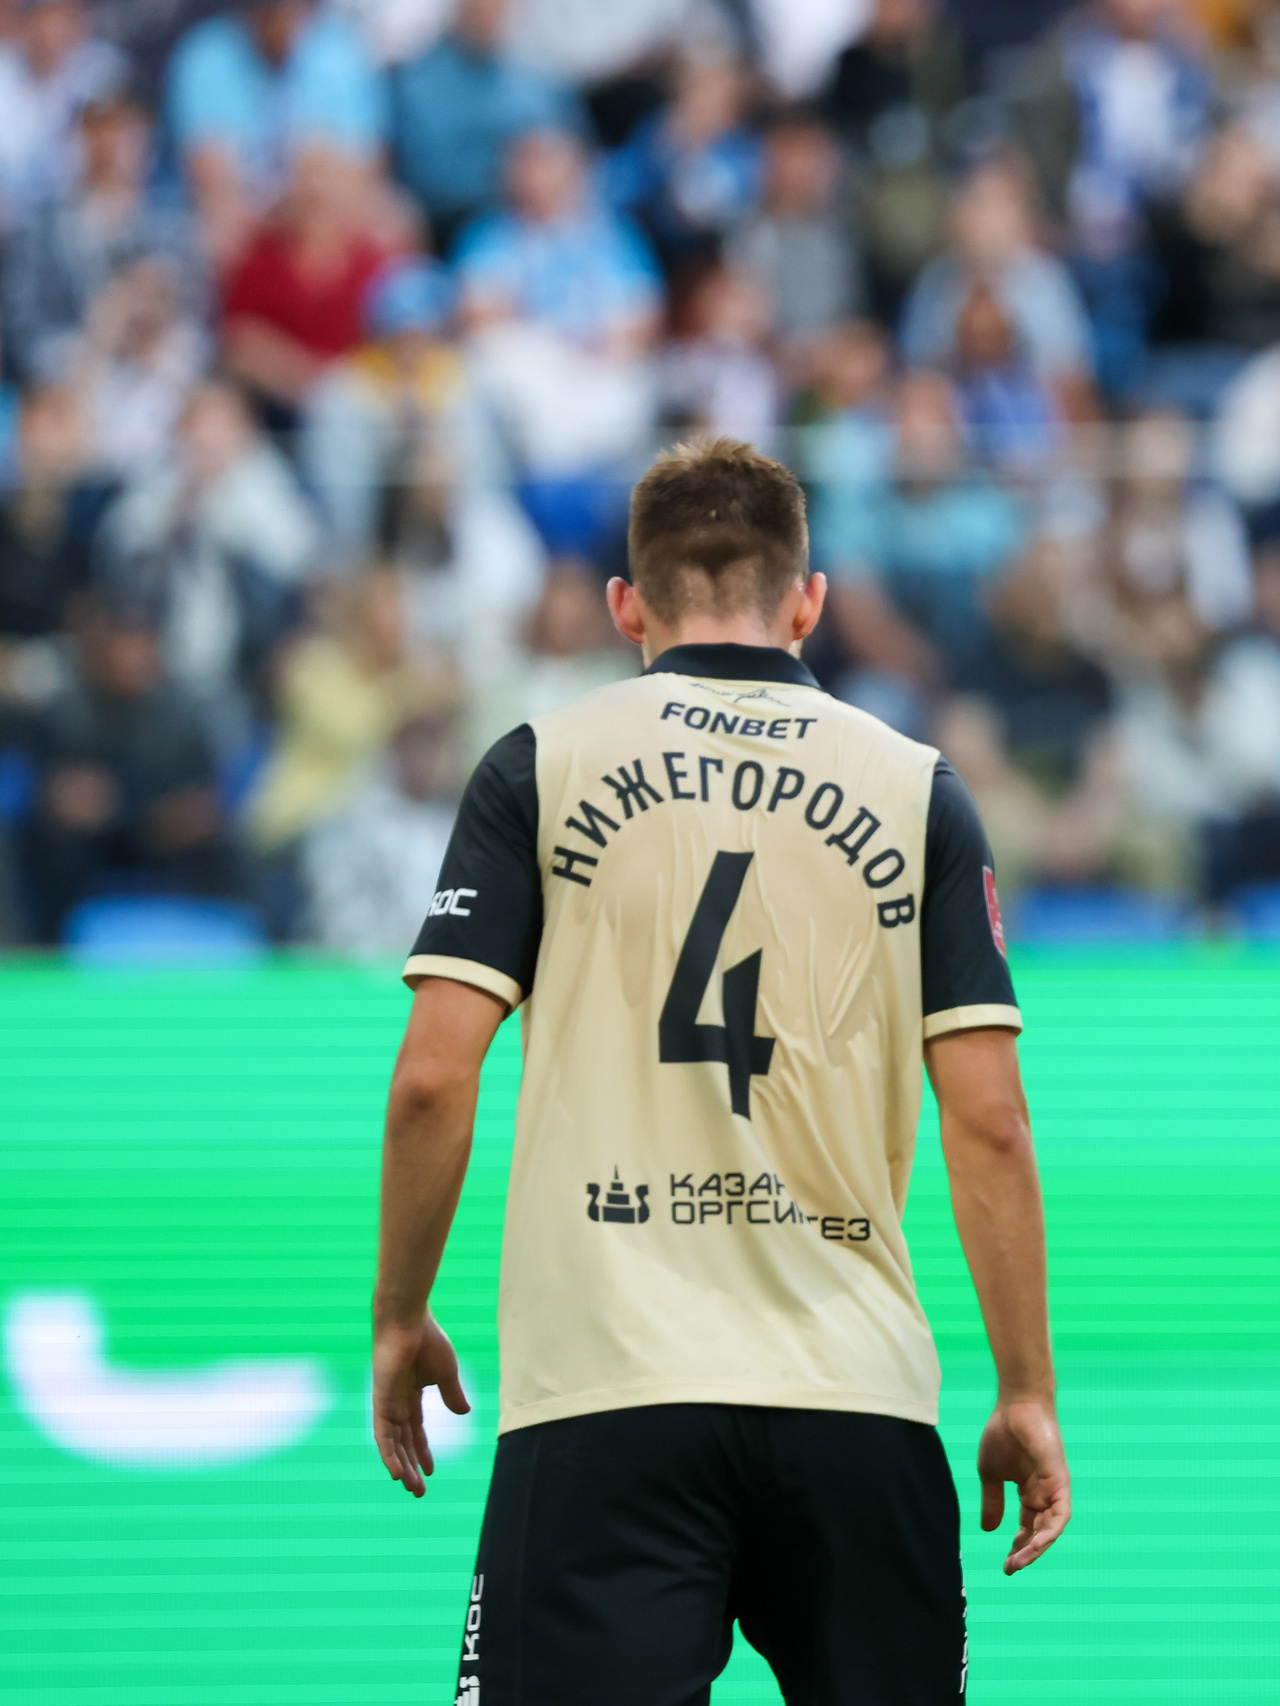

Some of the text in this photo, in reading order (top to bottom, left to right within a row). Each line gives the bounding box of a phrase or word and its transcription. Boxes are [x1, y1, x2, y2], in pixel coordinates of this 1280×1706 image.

[661, 702, 818, 739] FONBET
[552, 752, 915, 929] НИЖЕГОРОДОВ
[658, 849, 776, 1122] 4
